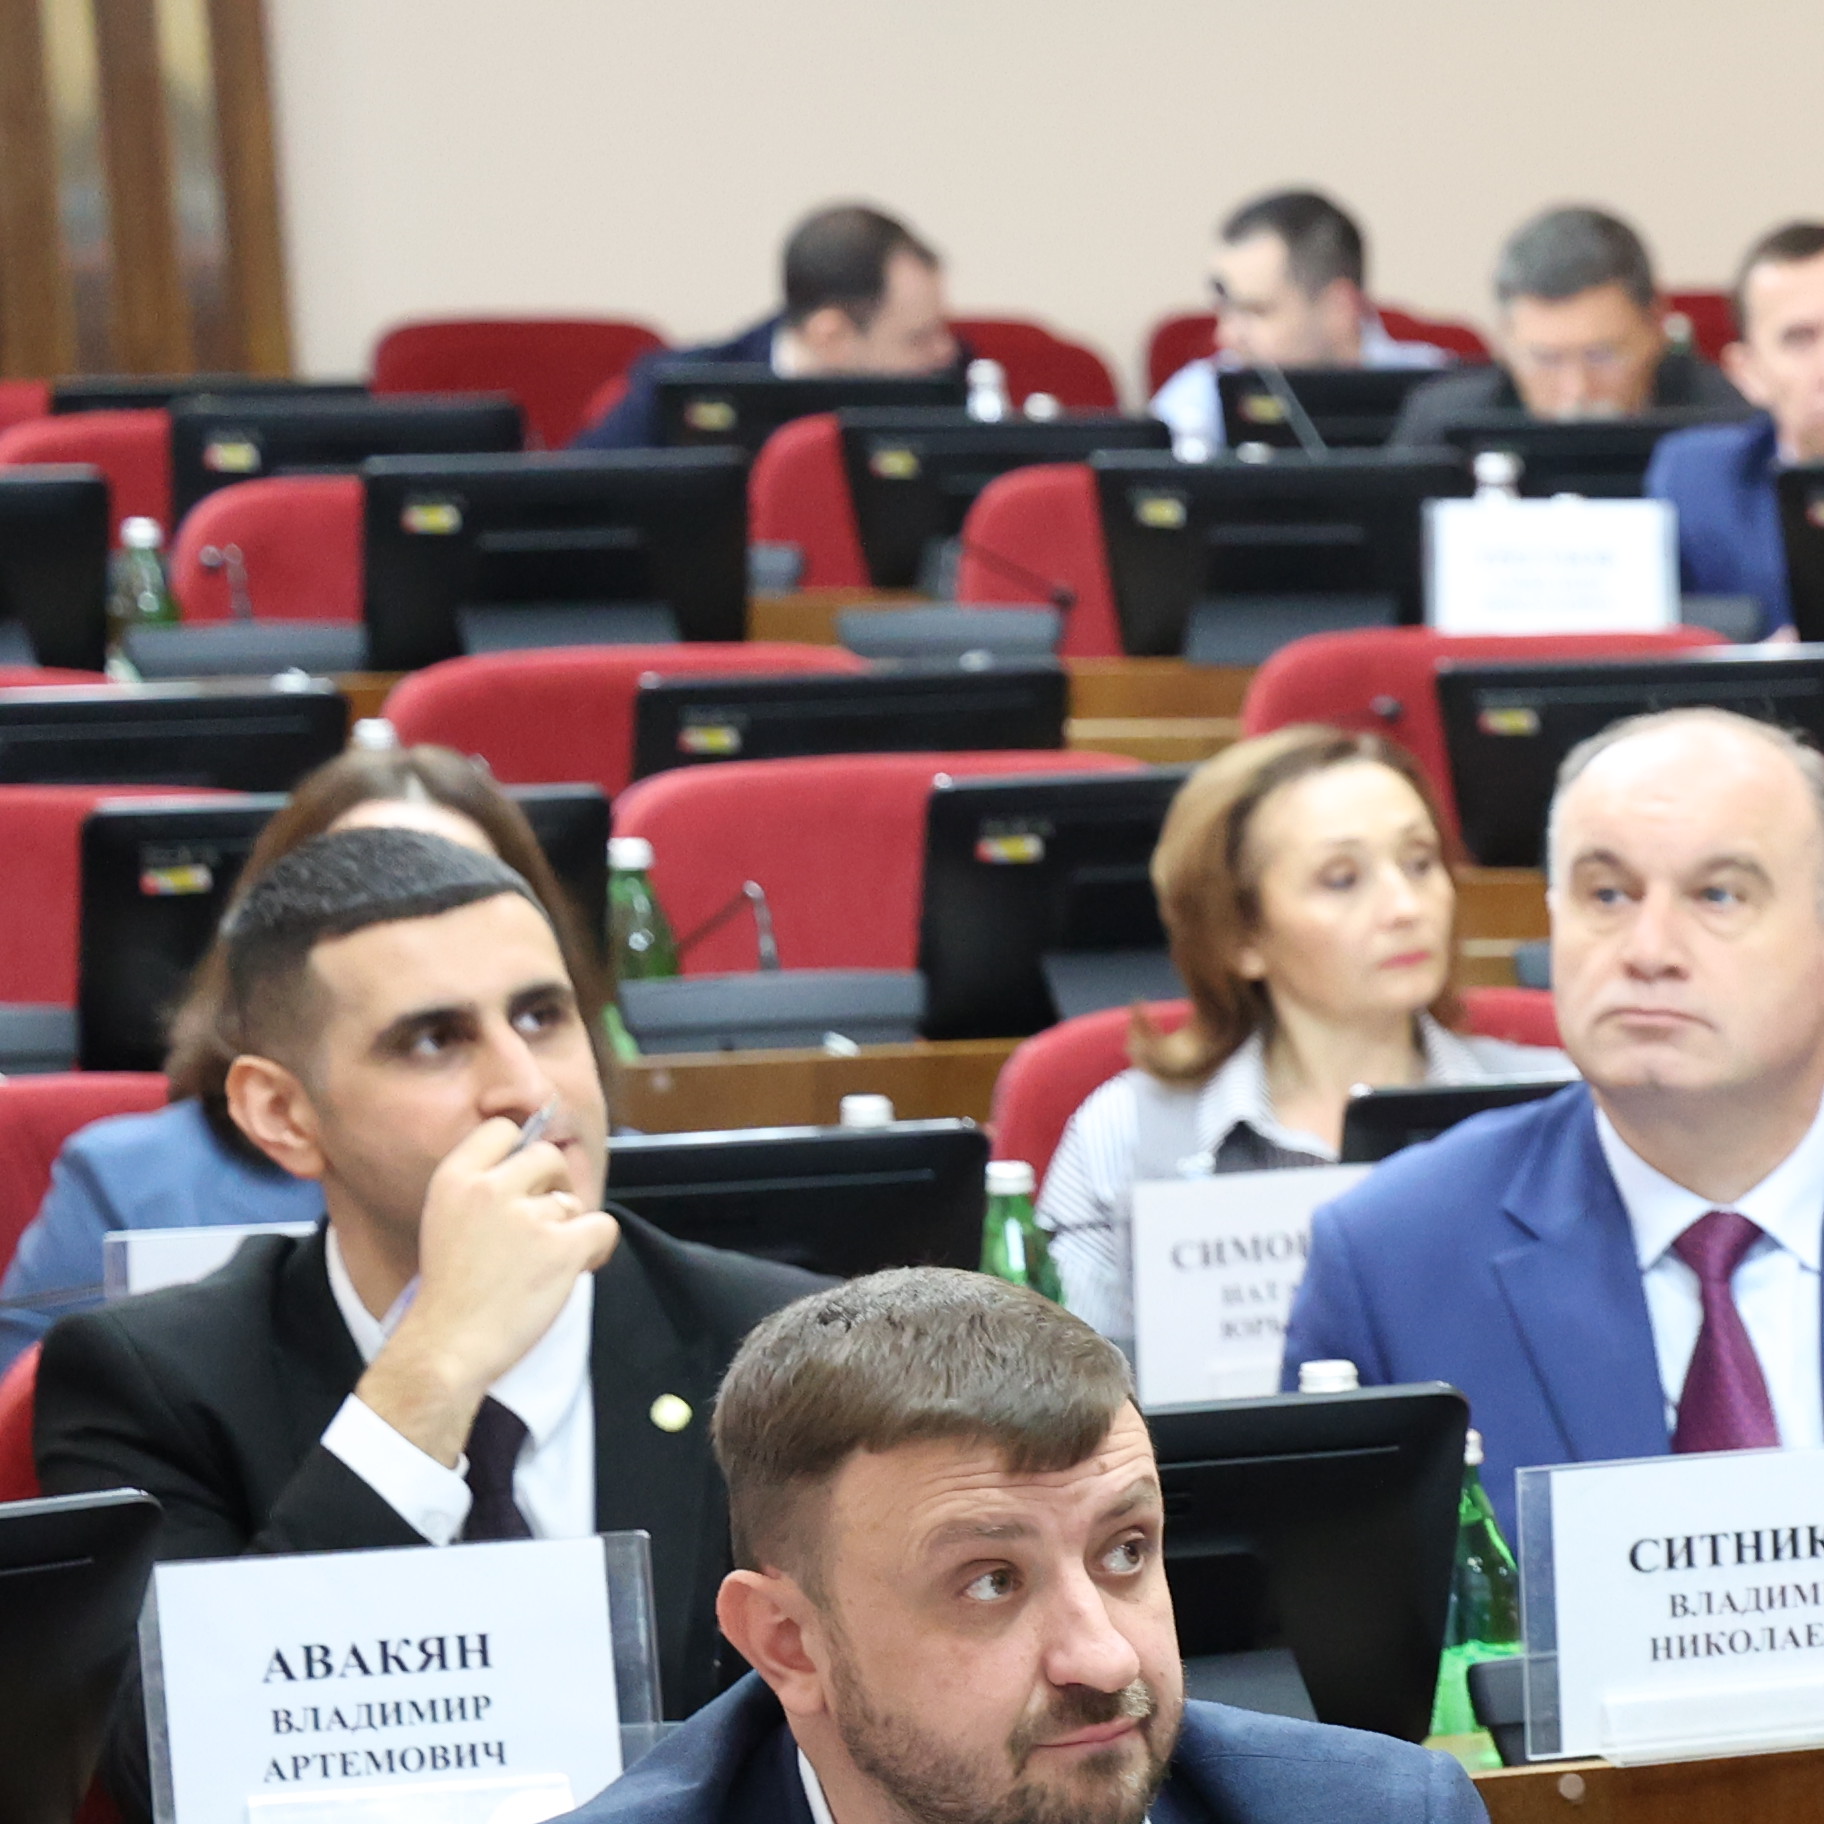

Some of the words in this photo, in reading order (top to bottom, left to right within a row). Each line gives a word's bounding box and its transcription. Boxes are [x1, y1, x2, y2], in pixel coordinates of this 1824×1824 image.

[262, 1632, 494, 1684] АВАКЯН
[271, 1694, 493, 1735] ВЛАДИМИР
[262, 1740, 508, 1783] АРТЕМОВИЧ
